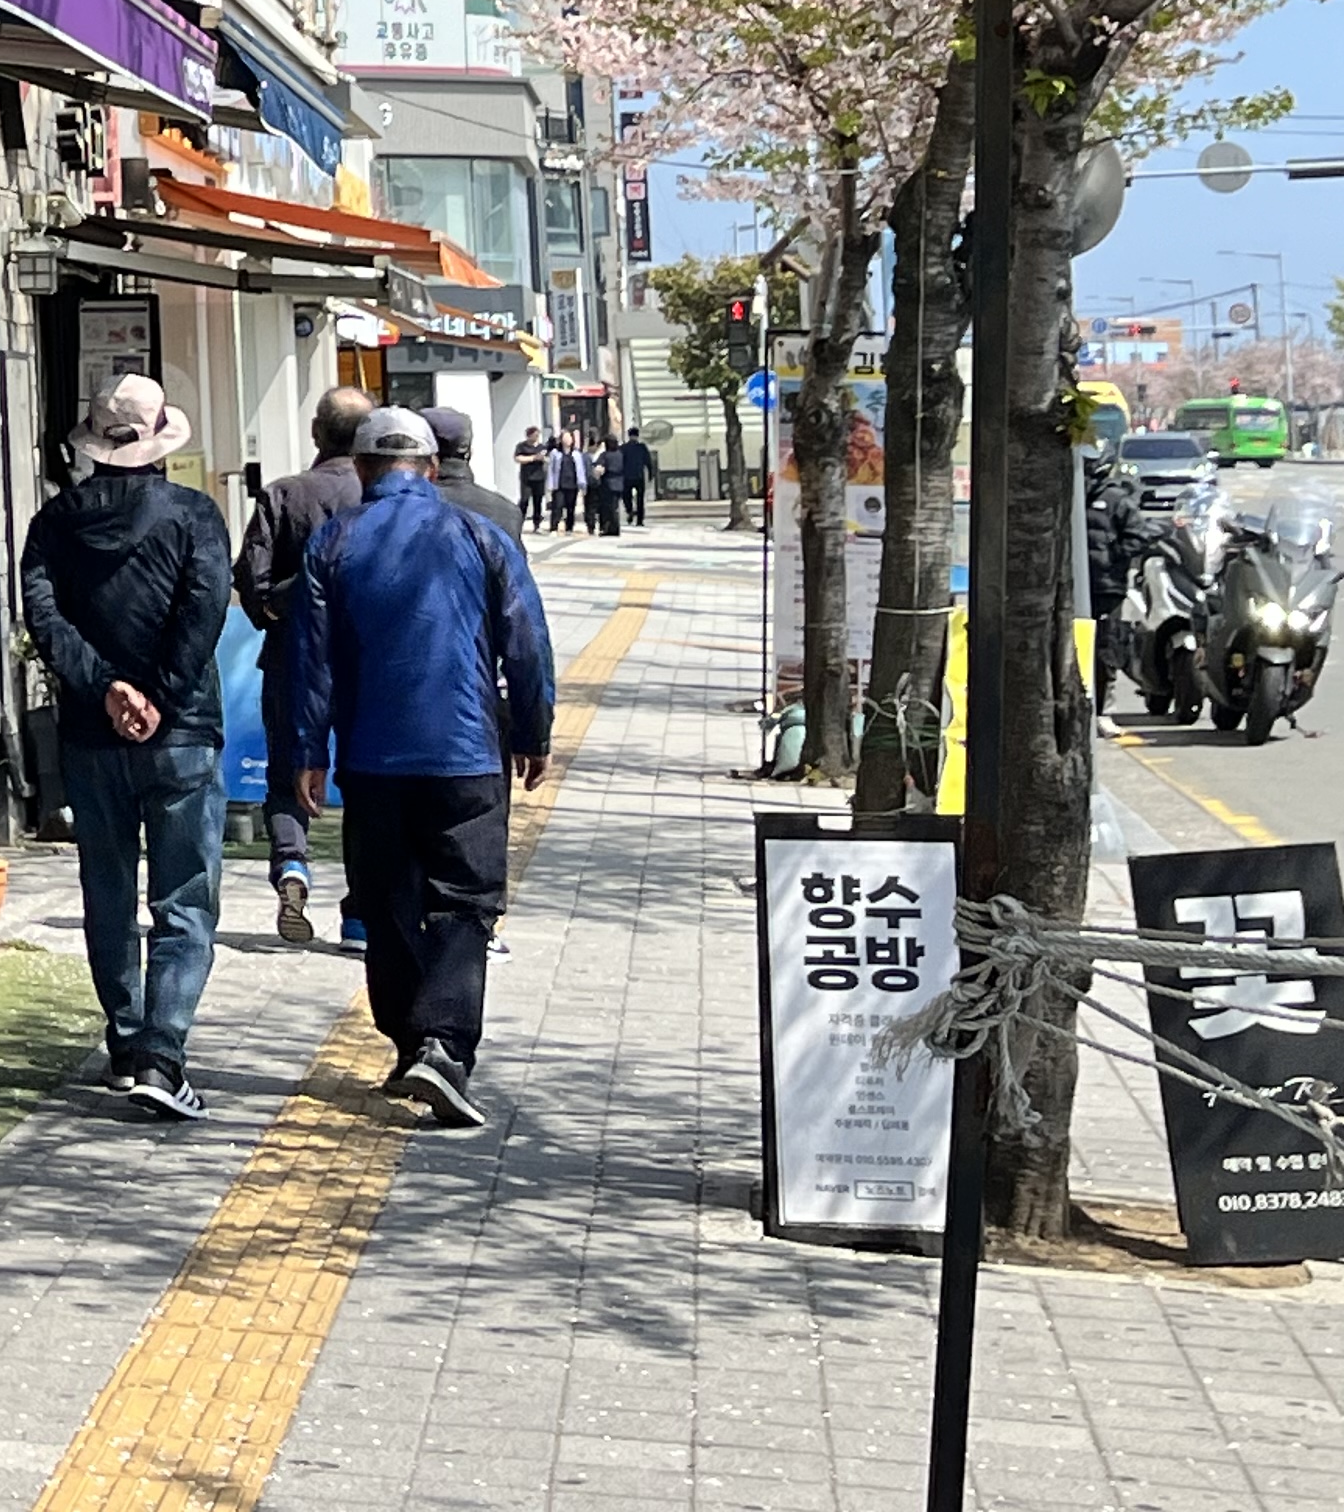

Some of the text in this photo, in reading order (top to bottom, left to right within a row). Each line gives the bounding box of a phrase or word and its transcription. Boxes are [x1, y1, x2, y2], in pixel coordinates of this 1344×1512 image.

[375, 21, 434, 41] 교통사고
[800, 872, 923, 931] 향수
[803, 934, 926, 994] 공방
